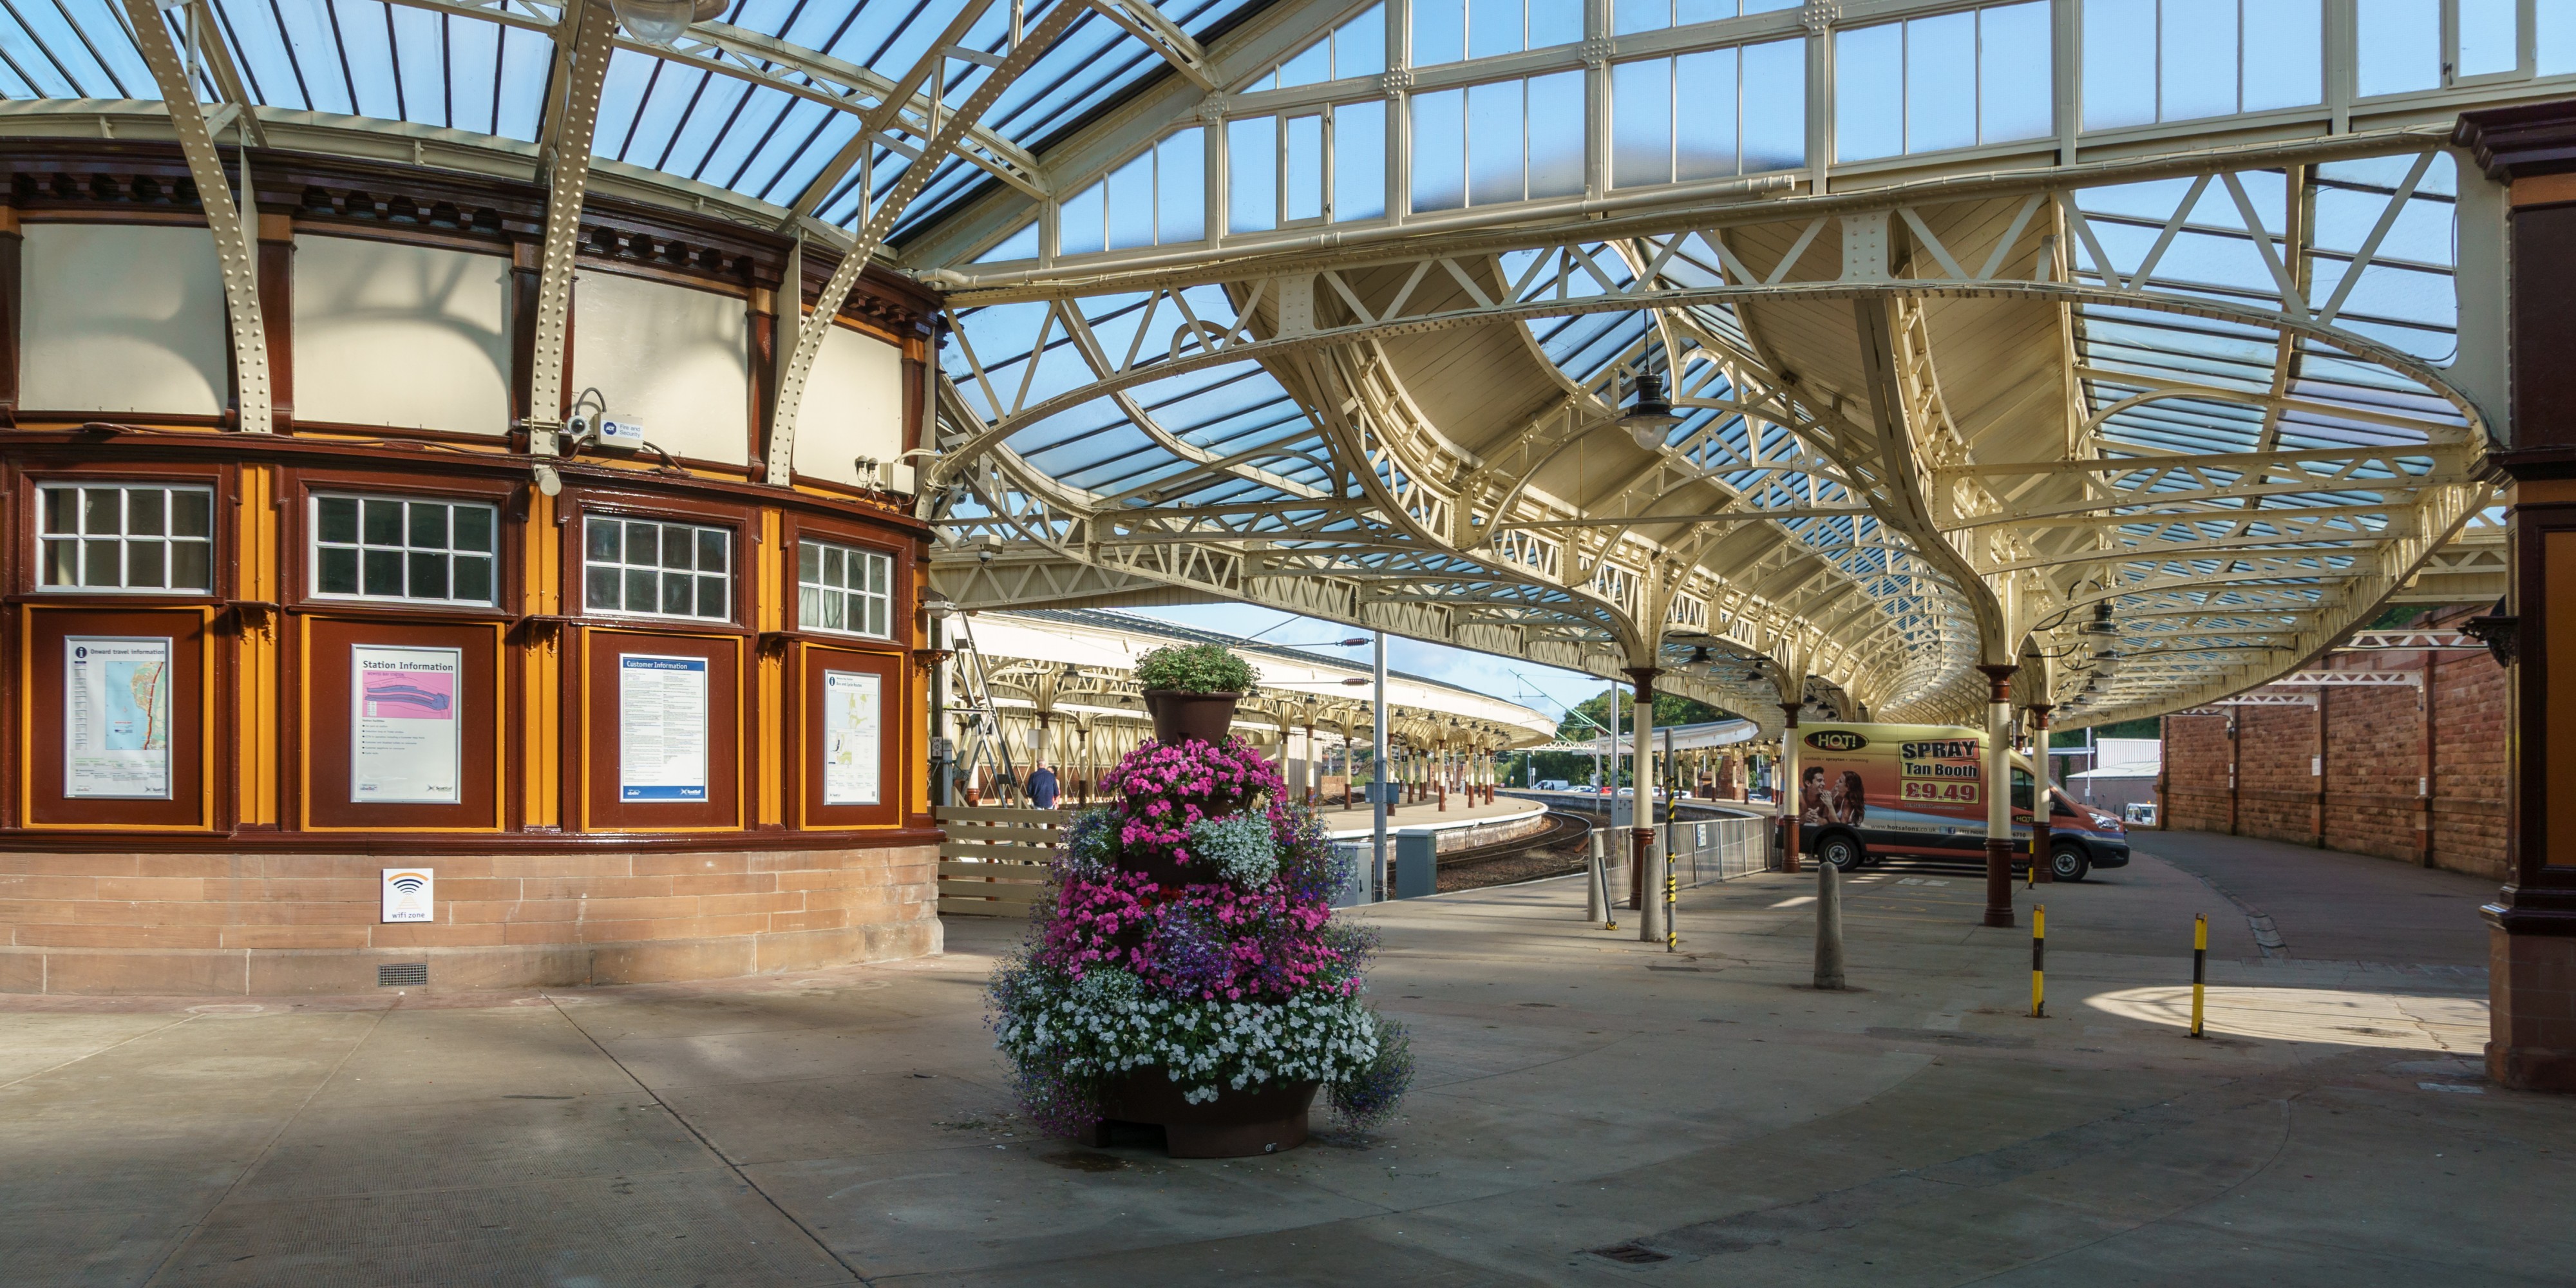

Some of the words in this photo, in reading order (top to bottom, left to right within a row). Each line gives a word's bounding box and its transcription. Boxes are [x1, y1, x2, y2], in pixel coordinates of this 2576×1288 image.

[363, 661, 395, 669] Station
[399, 662, 453, 671] Information
[1818, 734, 1856, 747] HOT!
[1902, 741, 1976, 760] SPRAY
[1905, 762, 1931, 775] Tan
[1935, 764, 1978, 777] Booth
[1905, 782, 1976, 802] £9.49
